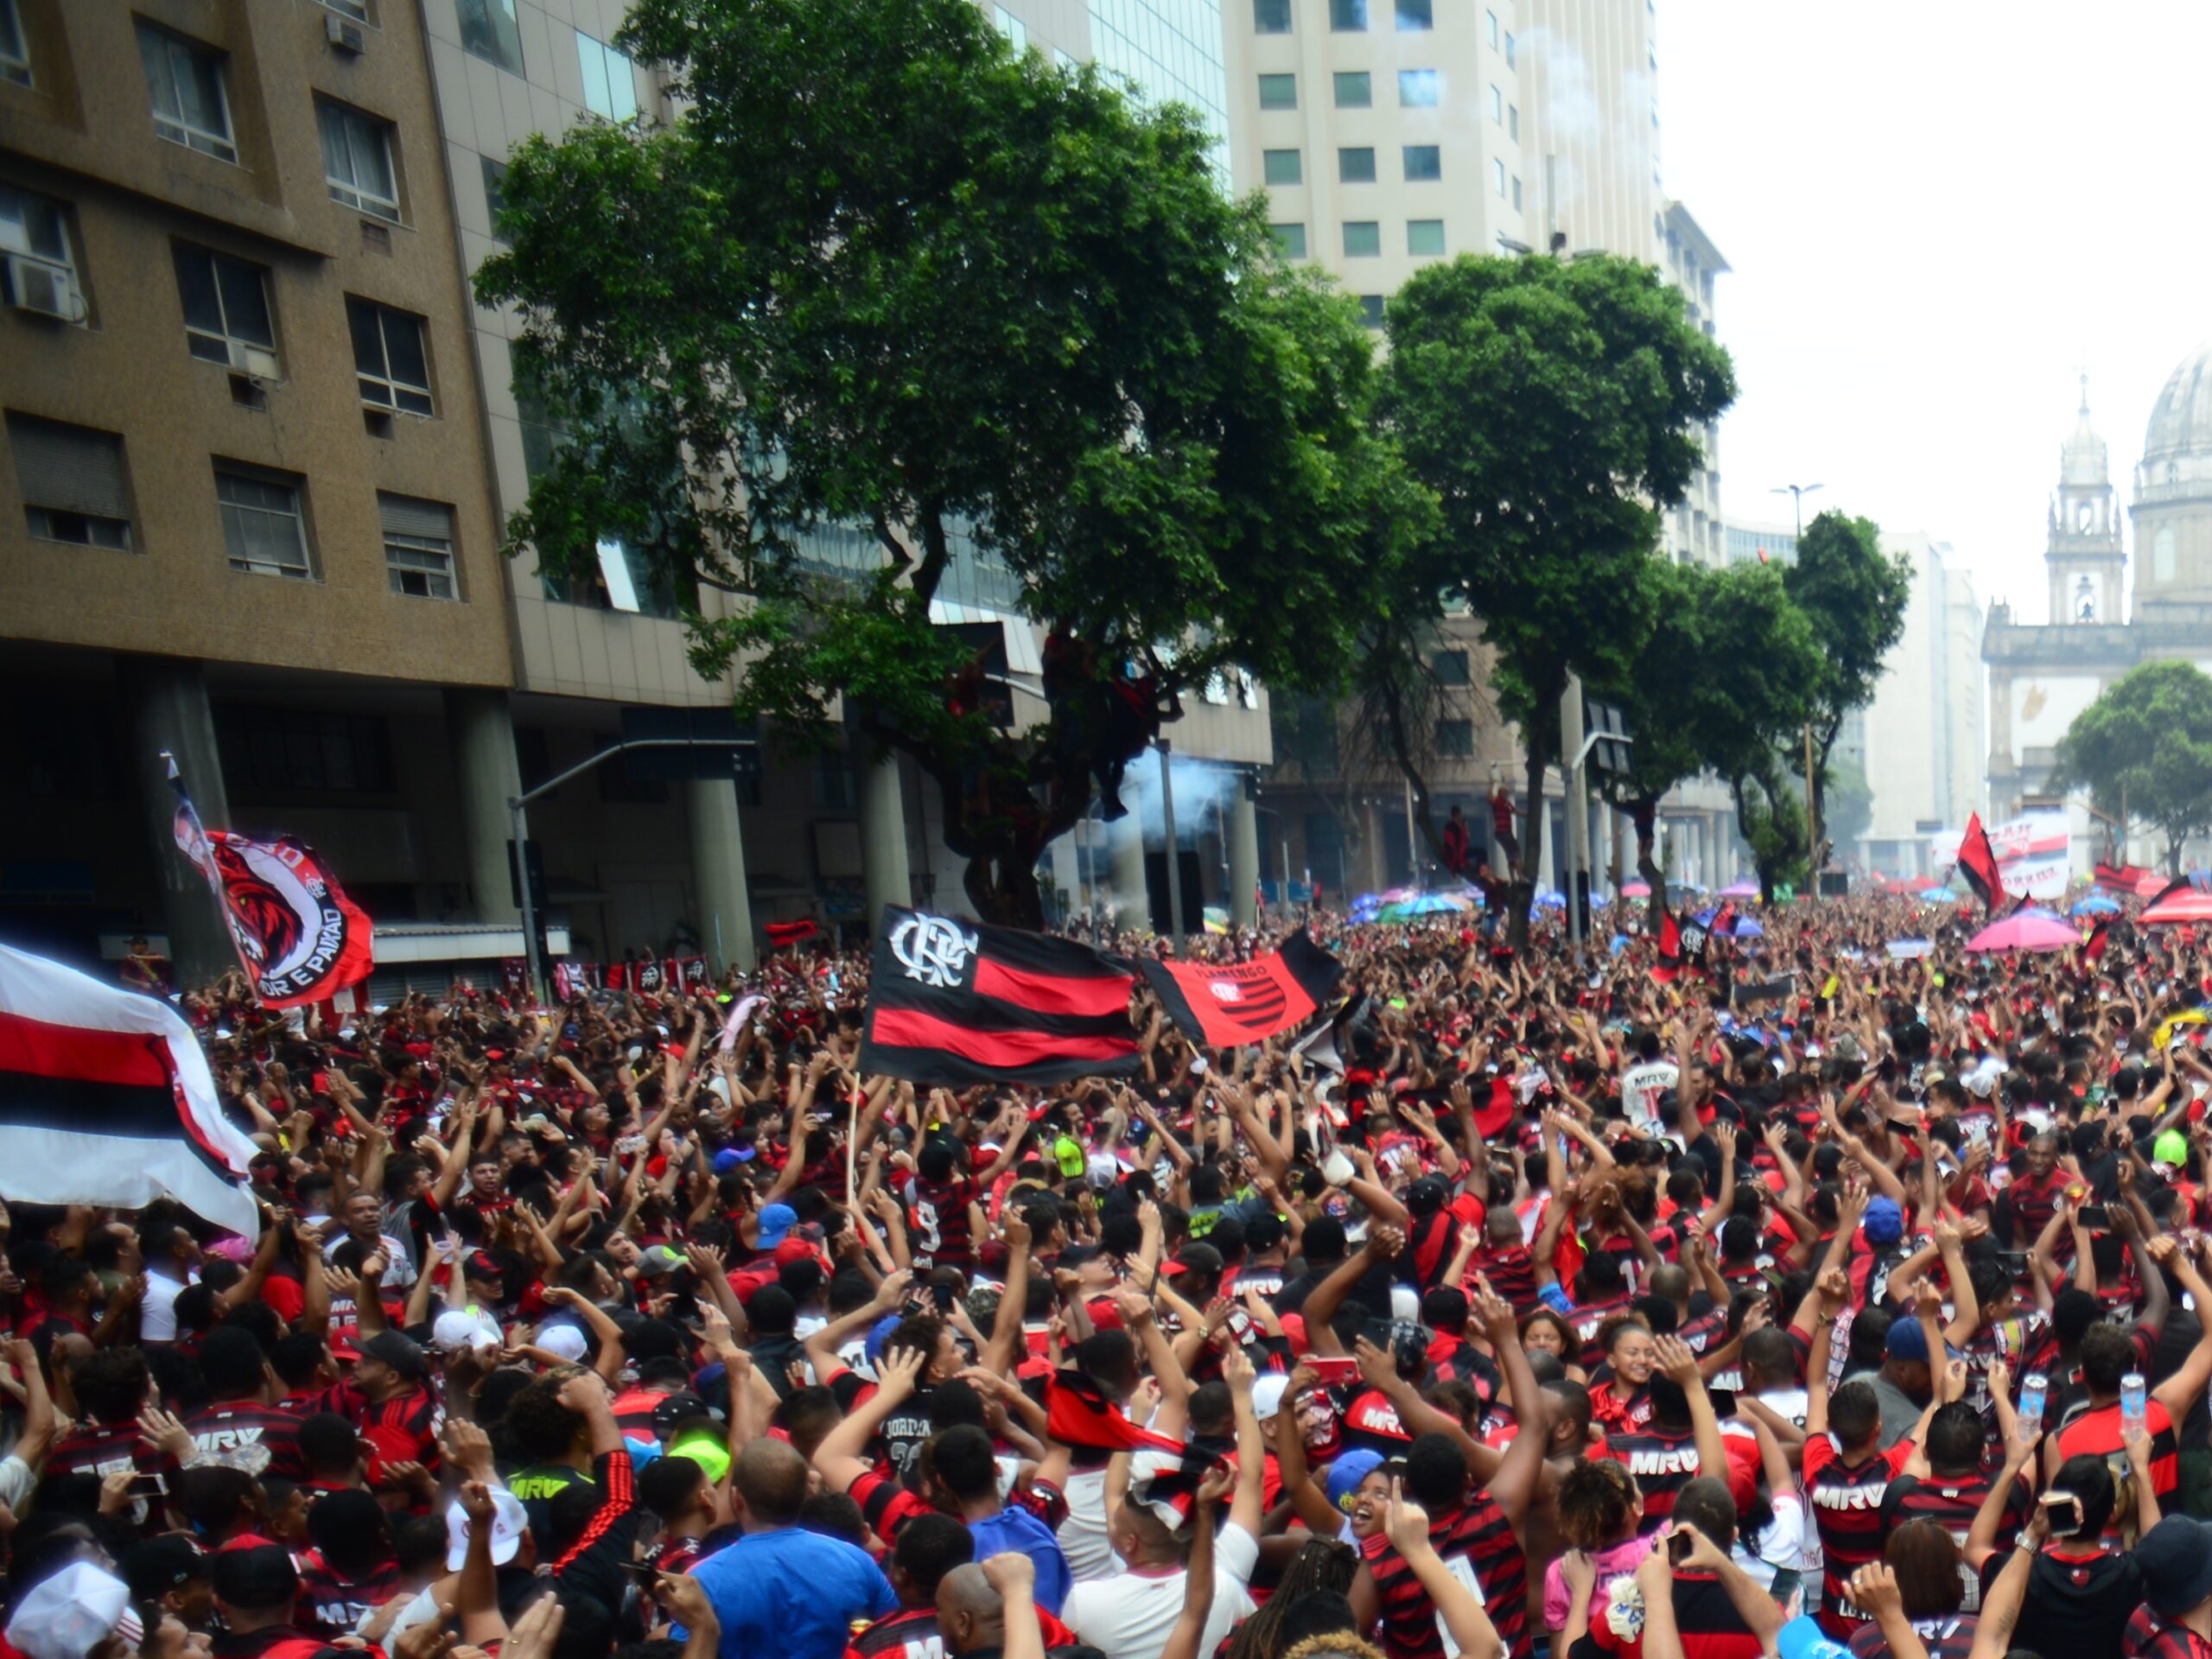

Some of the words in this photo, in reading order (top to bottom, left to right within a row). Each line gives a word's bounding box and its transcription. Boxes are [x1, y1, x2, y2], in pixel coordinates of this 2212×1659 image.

[1196, 965, 1268, 979] FLAMENGO
[1635, 1072, 1669, 1087] MRV
[1233, 1279, 1283, 1297] MRV
[1630, 1449, 1700, 1475] MRV
[511, 1477, 569, 1500] MRV
[1813, 1483, 1888, 1510] MRV
